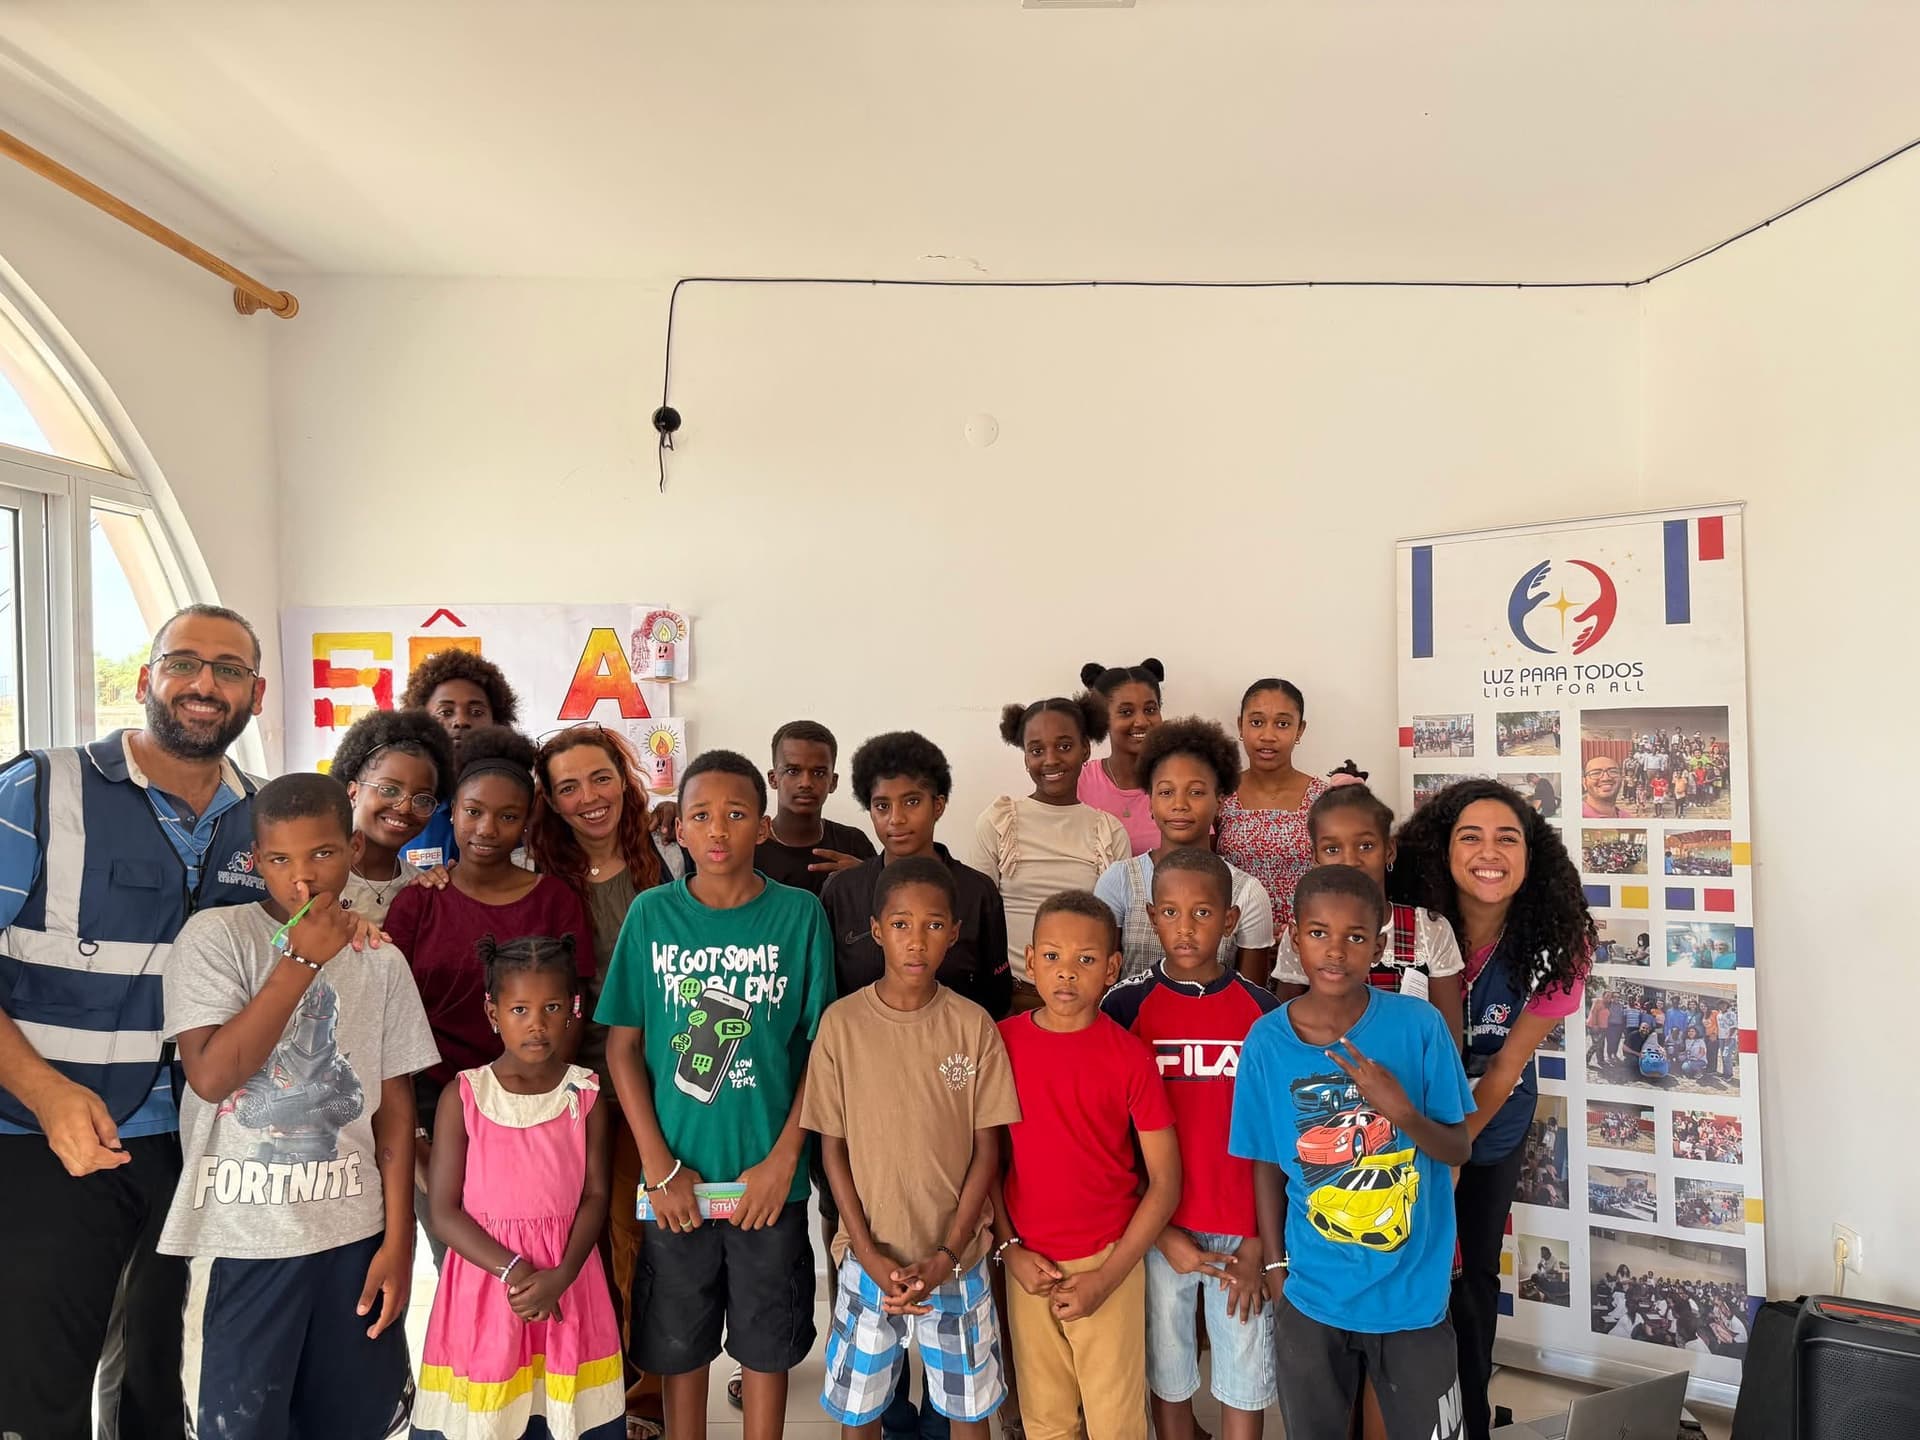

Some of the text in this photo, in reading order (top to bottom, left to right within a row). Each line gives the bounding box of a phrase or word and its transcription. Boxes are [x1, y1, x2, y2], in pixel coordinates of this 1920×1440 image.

[1483, 662, 1644, 685] LUZ PARA TODOS
[1483, 680, 1645, 698] LIGHT FOR ALL
[652, 941, 779, 975] WE GOT SOME
[735, 1058, 753, 1068] LOW
[939, 1053, 976, 1076] HAWAII
[1155, 1044, 1240, 1077] FILA
[728, 1067, 748, 1079] BAT
[192, 1150, 364, 1211] FORTNITE
